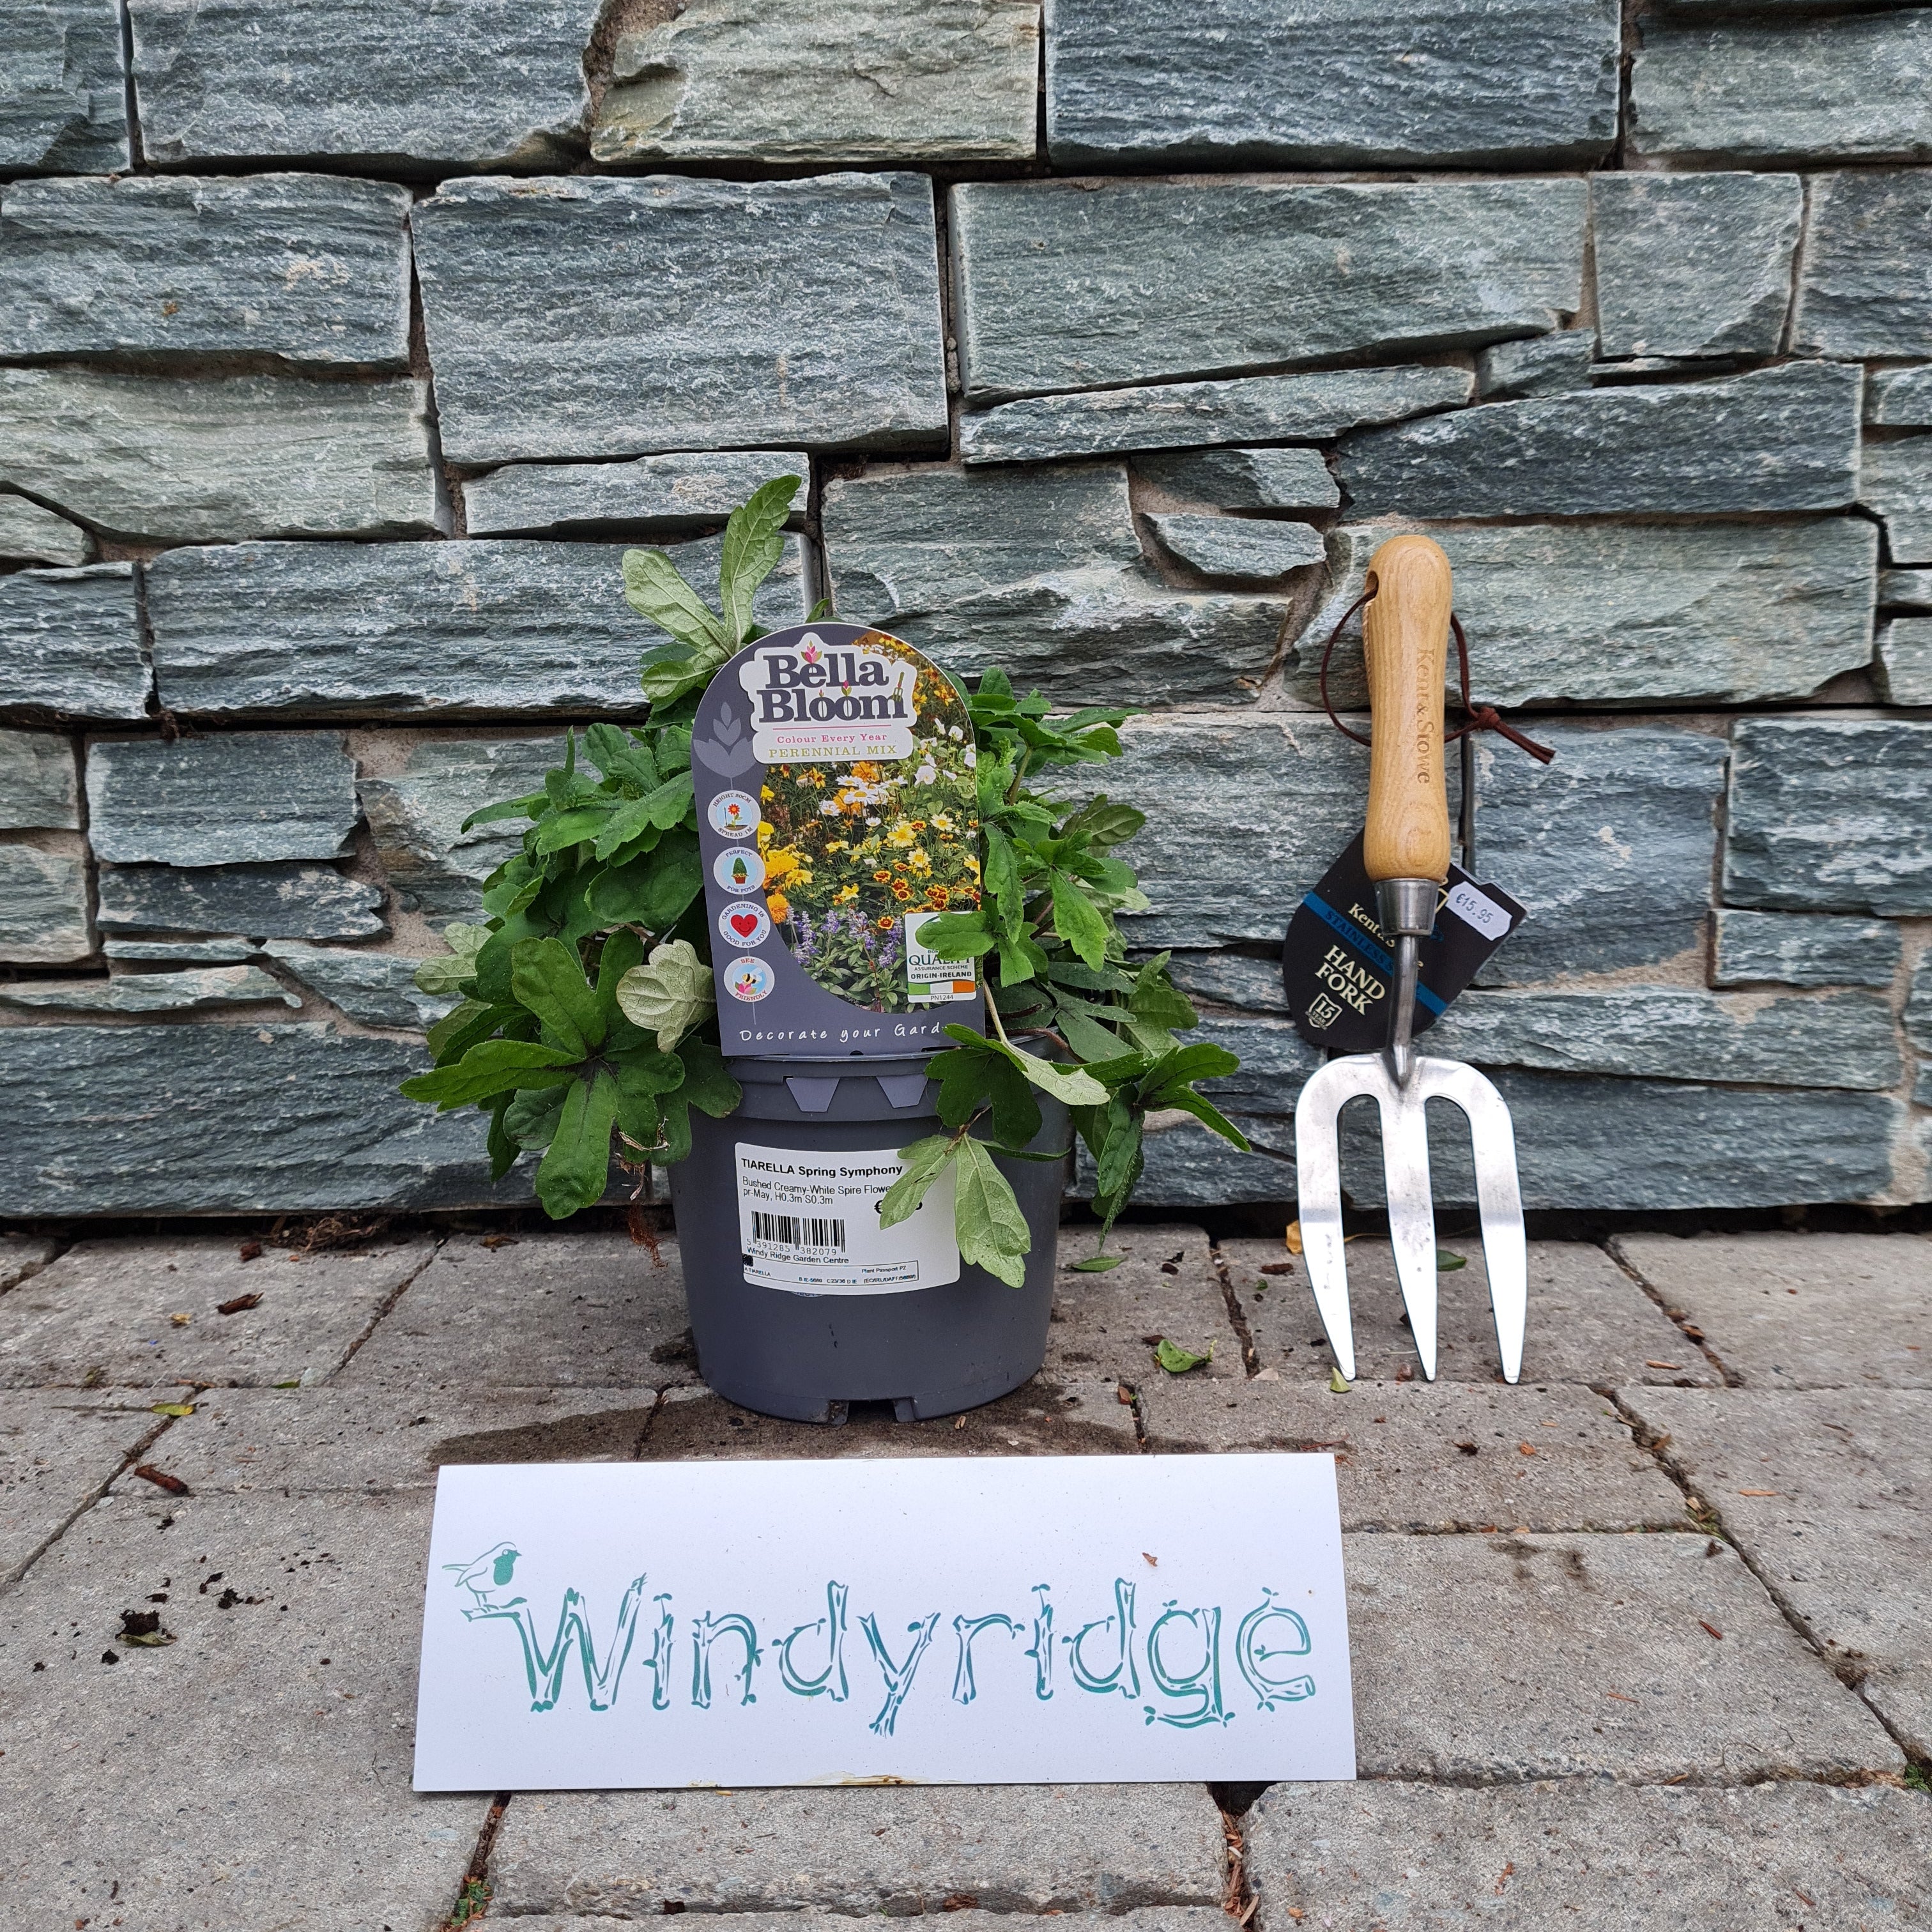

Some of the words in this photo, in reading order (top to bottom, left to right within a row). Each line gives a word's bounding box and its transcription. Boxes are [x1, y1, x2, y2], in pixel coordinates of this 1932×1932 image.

[763, 652, 889, 689] Bella
[1416, 648, 1435, 700] Kent
[756, 689, 907, 723] Bloom
[1417, 703, 1428, 716] &
[777, 735, 816, 744] Colour
[822, 734, 855, 744] Every
[860, 733, 887, 741] Year
[769, 747, 860, 758] PERENNIAL
[867, 746, 897, 754] MIX
[1417, 720, 1434, 784] Stowe
[713, 793, 733, 807] HEIGHT
[735, 793, 751, 803] 20CM
[718, 828, 742, 837] SPREAD
[722, 904, 758, 919] GARDENING
[1348, 902, 1380, 933] Kent
[1456, 893, 1494, 924] €15.95
[723, 931, 739, 944] GOOD
[756, 930, 767, 941] YOU
[1324, 944, 1385, 999] HAND
[735, 990, 767, 1000] FRIENDLY
[1315, 962, 1374, 1015] FORK
[1315, 1000, 1335, 1018] 15
[740, 1029, 827, 1041] Decorate
[839, 1028, 880, 1043] your
[894, 1022, 942, 1036] Gard
[741, 1158, 795, 1174] TIARELLA
[799, 1166, 836, 1178] Spring
[839, 1166, 902, 1178] Symphony
[742, 1176, 771, 1190] Bushed
[774, 1182, 834, 1195] Creamy-White
[838, 1186, 861, 1196] Spire
[864, 1184, 892, 1193] Flowe
[744, 1188, 772, 1201] pr-May,
[776, 1192, 802, 1203] H0.3m
[805, 1195, 833, 1204] S0.3m
[747, 1246, 768, 1257] Windy
[770, 1251, 791, 1261] Ridge
[793, 1255, 820, 1263] Garden
[756, 1241, 790, 1252] 391285
[800, 1247, 837, 1255] 382079
[749, 1268, 771, 1276] TIARELLA
[460, 1572, 1317, 1737] Windyridge
